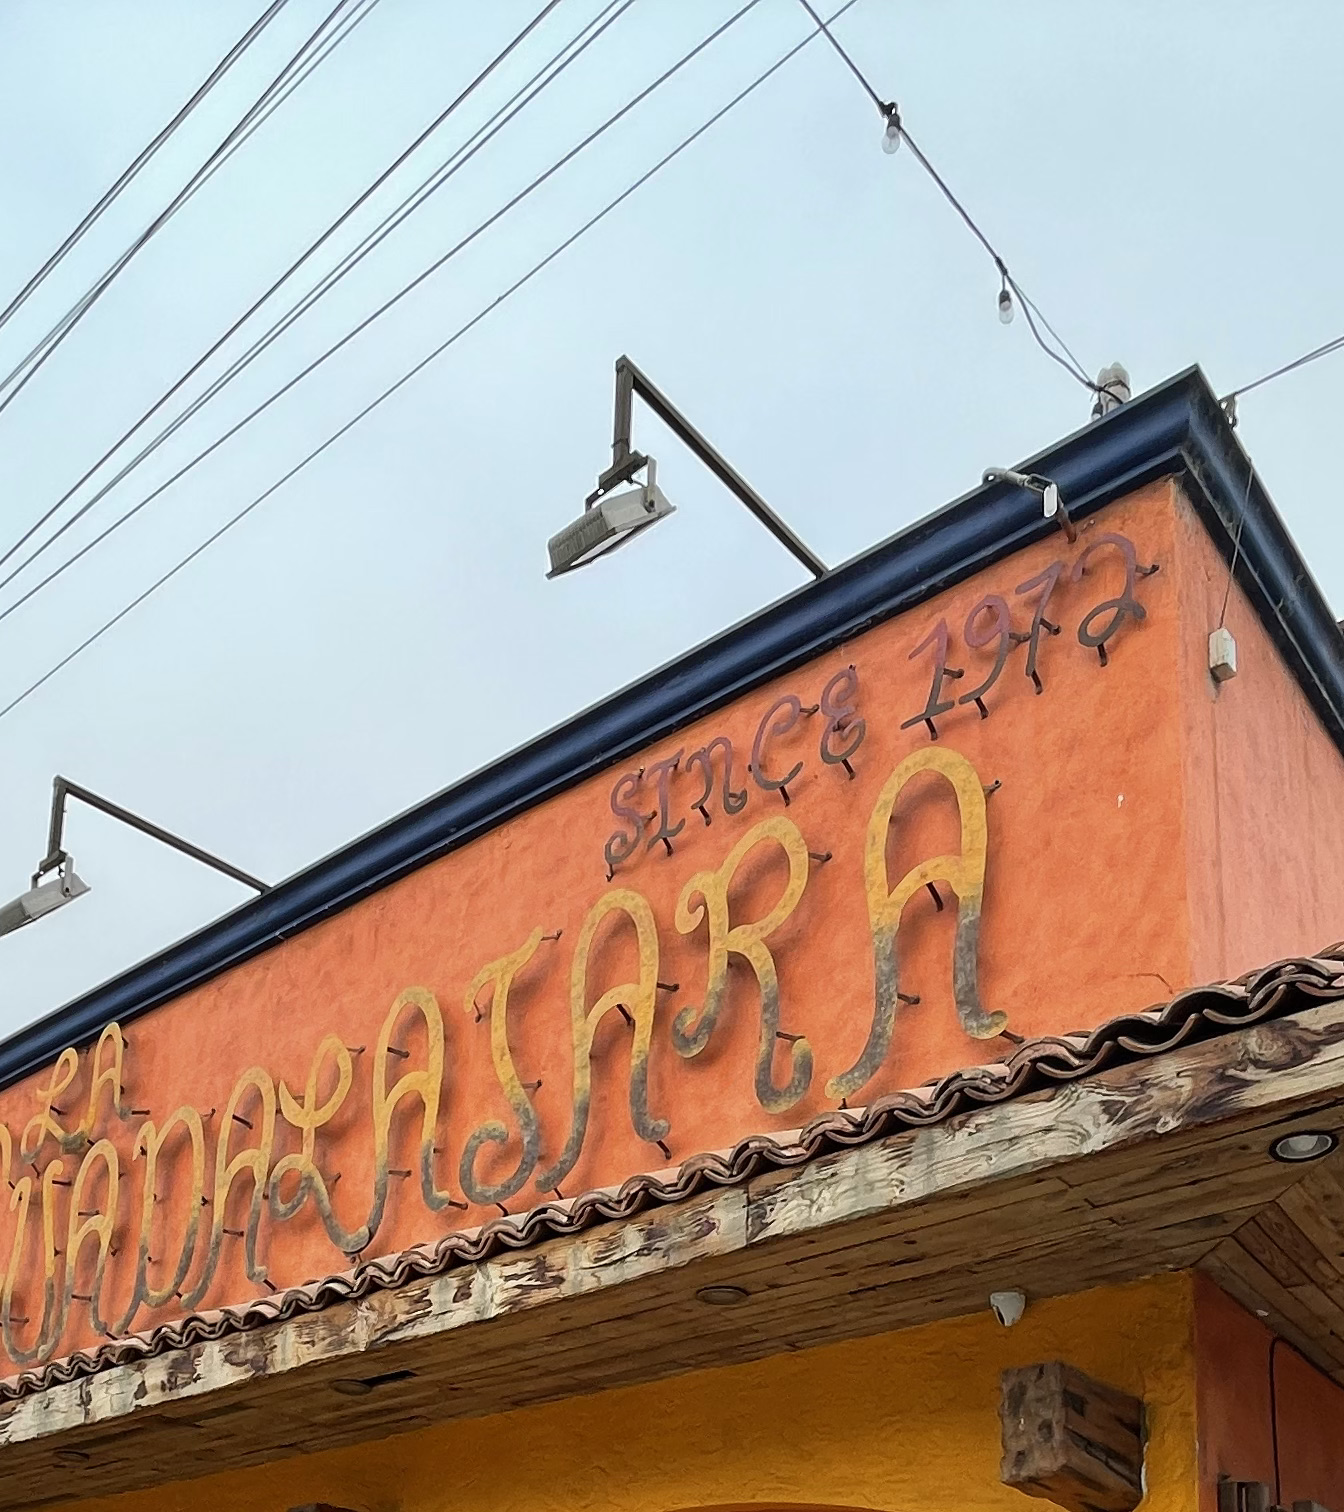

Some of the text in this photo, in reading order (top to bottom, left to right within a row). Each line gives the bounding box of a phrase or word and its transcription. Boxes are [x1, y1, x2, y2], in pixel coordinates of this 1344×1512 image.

[604, 533, 1147, 865] SINCE 1972
[20, 1021, 134, 1163] LA
